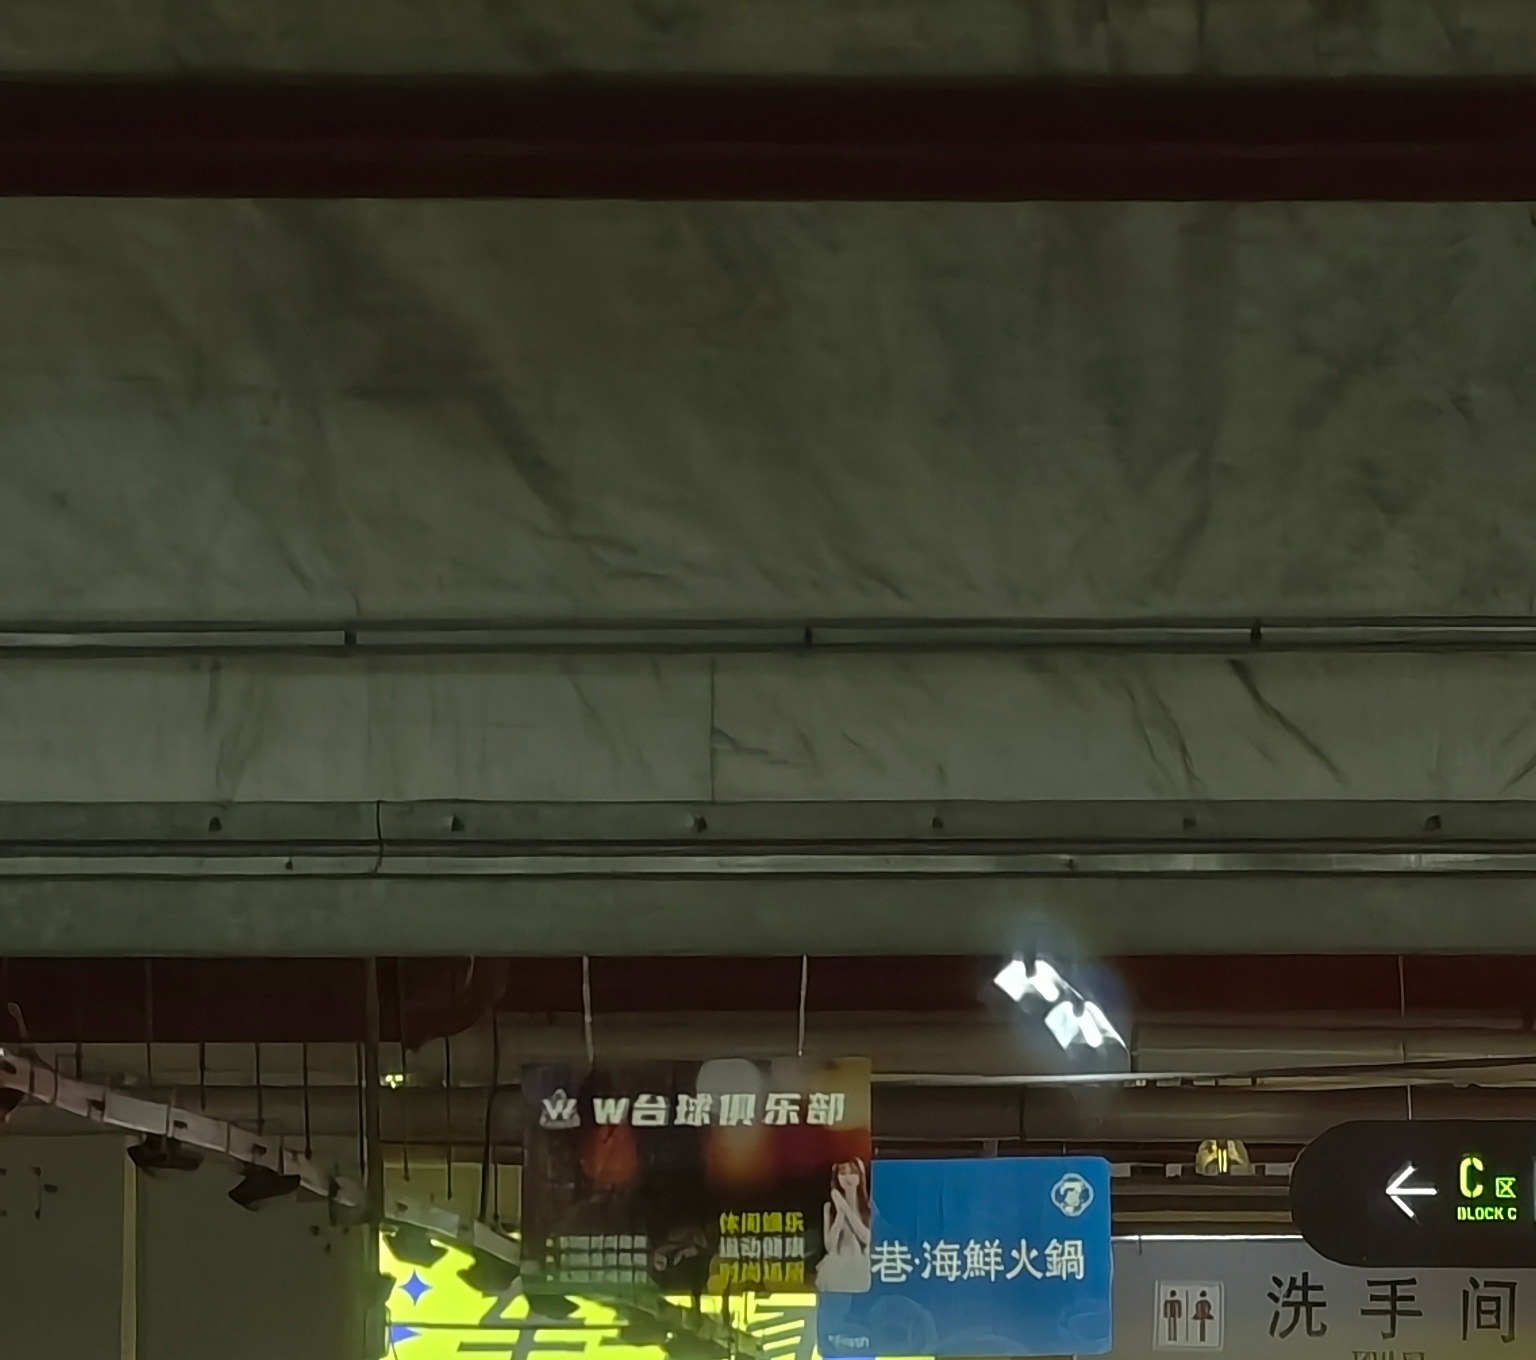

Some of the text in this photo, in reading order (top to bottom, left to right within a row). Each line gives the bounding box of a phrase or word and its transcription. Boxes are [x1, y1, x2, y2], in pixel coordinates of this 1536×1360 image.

[592, 1093, 845, 1127] W台球俱乐部
[1457, 1206, 1517, 1221] BLOCK C
[1267, 1271, 1519, 1344] 洗手间
